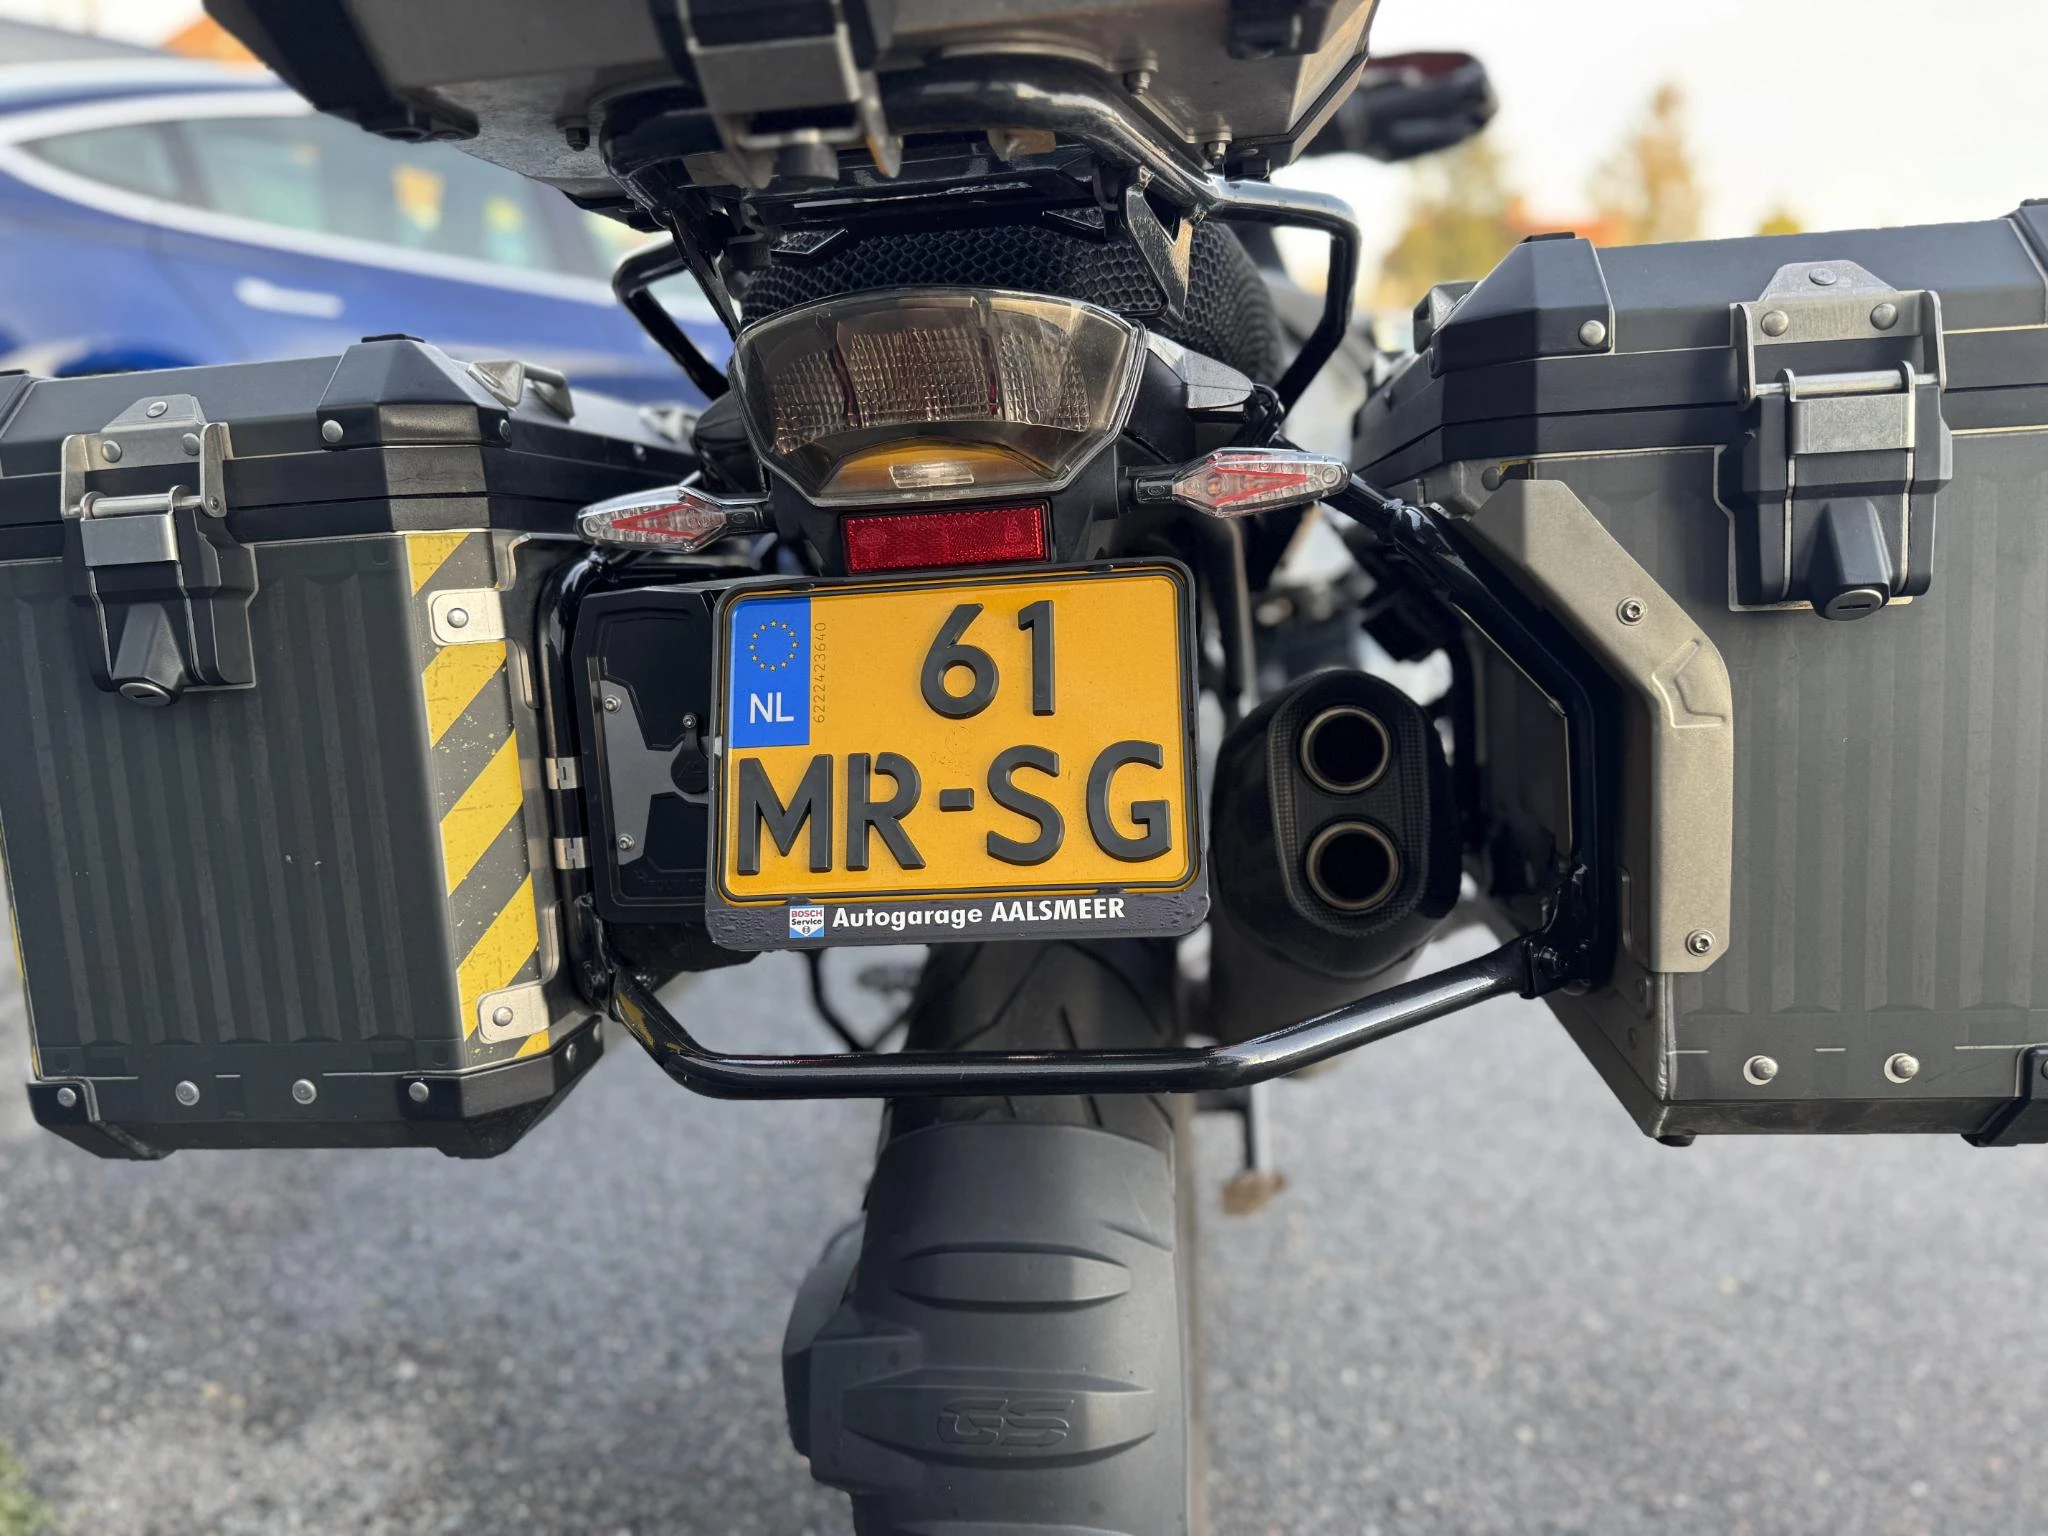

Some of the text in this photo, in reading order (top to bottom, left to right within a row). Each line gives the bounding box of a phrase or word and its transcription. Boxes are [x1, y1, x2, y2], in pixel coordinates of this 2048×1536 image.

[813, 622, 826, 723] 6222423640
[920, 600, 1055, 720] 61
[750, 692, 794, 723] NL
[736, 740, 1173, 876] MR-SG
[791, 909, 823, 918] BOSCH
[791, 918, 822, 926] Service
[832, 897, 1125, 931] Autogarage AALSMEER
[936, 1398, 1074, 1448] GS
